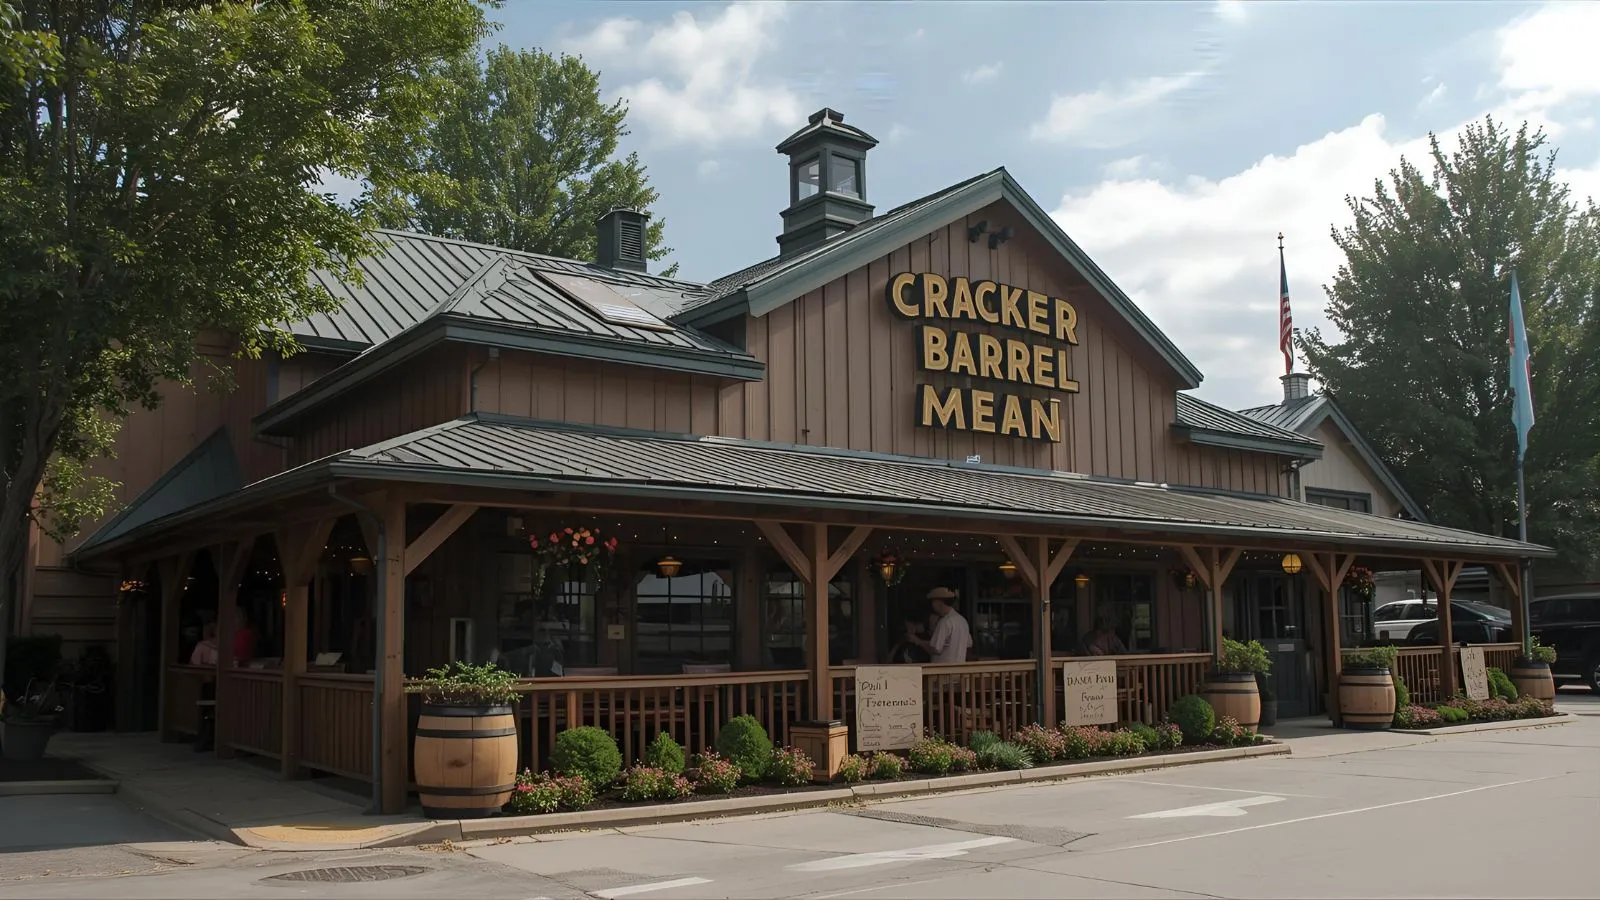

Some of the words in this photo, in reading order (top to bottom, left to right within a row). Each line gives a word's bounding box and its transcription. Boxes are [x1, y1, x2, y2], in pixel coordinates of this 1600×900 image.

[891, 272, 1079, 345] CRACKER
[922, 325, 1080, 392] BARREL
[922, 384, 1062, 443] MEAN
